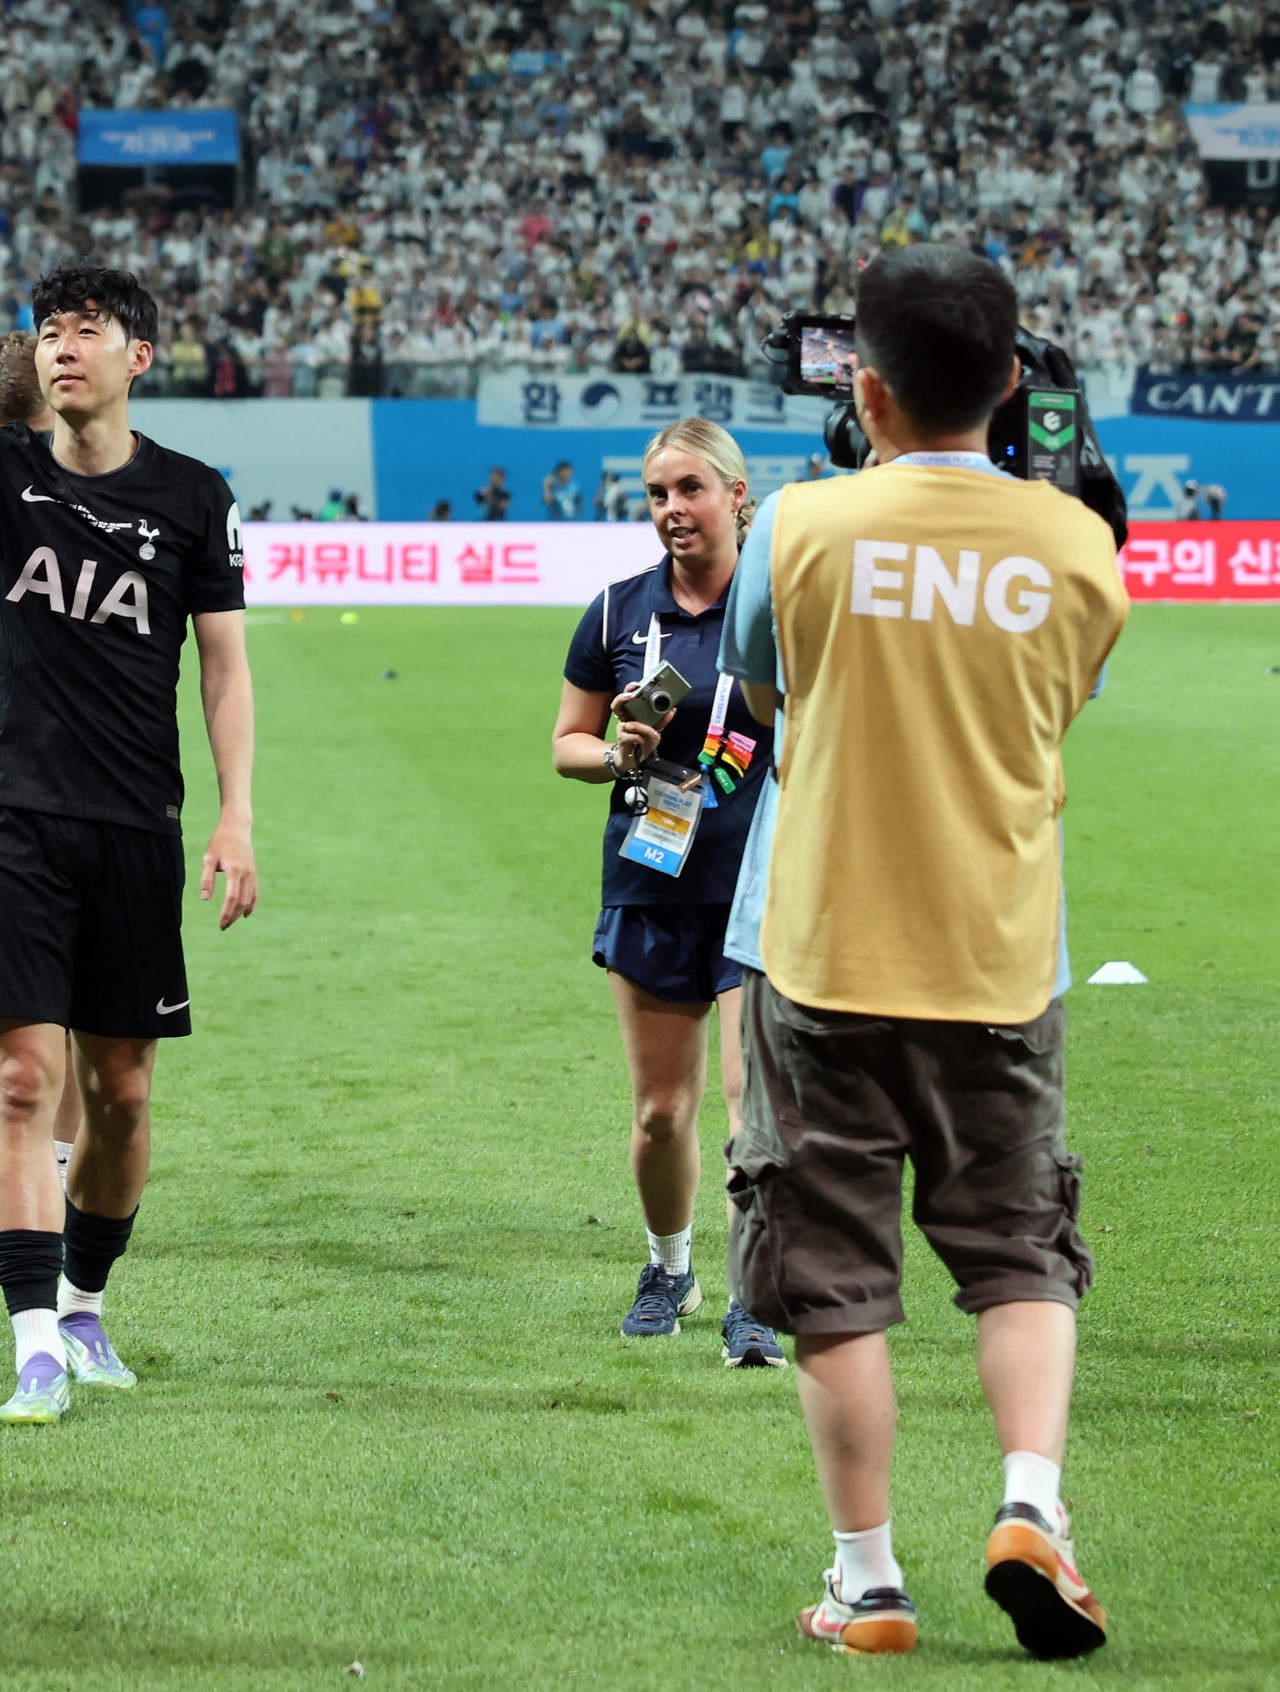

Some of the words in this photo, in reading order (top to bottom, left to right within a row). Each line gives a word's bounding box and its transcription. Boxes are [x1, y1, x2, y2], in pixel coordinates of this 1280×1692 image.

[269, 543, 438, 584] 커뮤니티
[455, 543, 540, 584] 실드
[1117, 539, 1215, 586] 구의
[1228, 539, 1280, 585] 신
[5, 546, 151, 635] AIA
[850, 540, 1052, 633] ENG
[715, 702, 725, 724] SERIES
[644, 846, 665, 863] M2
